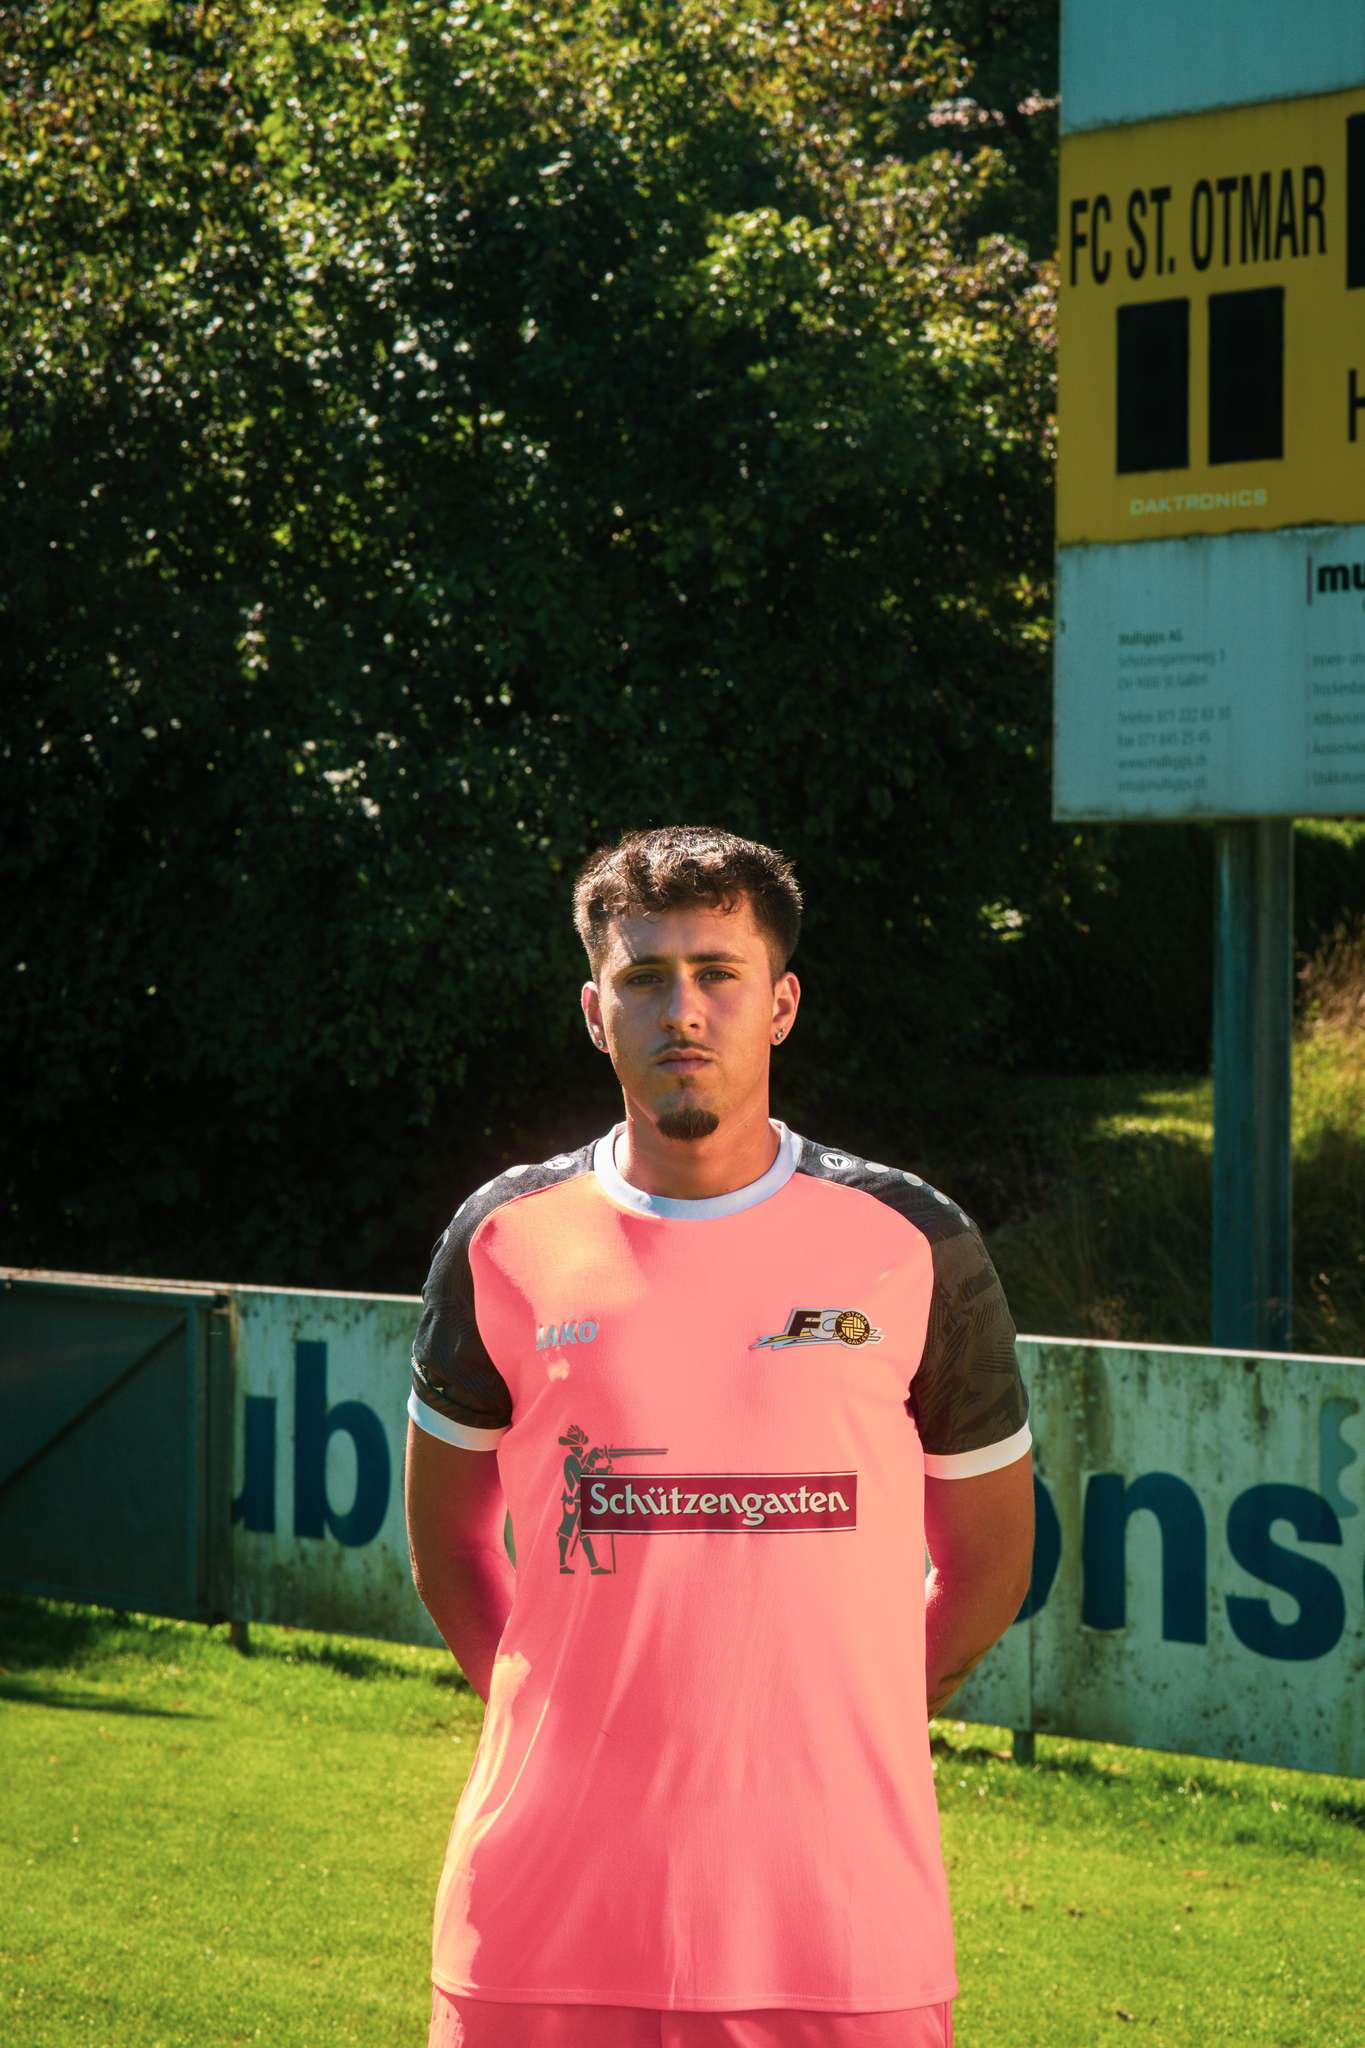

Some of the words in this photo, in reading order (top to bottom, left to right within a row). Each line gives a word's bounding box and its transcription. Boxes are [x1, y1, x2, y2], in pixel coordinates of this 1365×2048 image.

[1070, 194, 1112, 287] FC
[1126, 186, 1176, 280] ST.
[1191, 165, 1327, 272] OTMAR
[1129, 489, 1268, 516] DAKTRONICS
[535, 1320, 598, 1351] JAKO
[589, 1483, 850, 1527] Schützengarten
